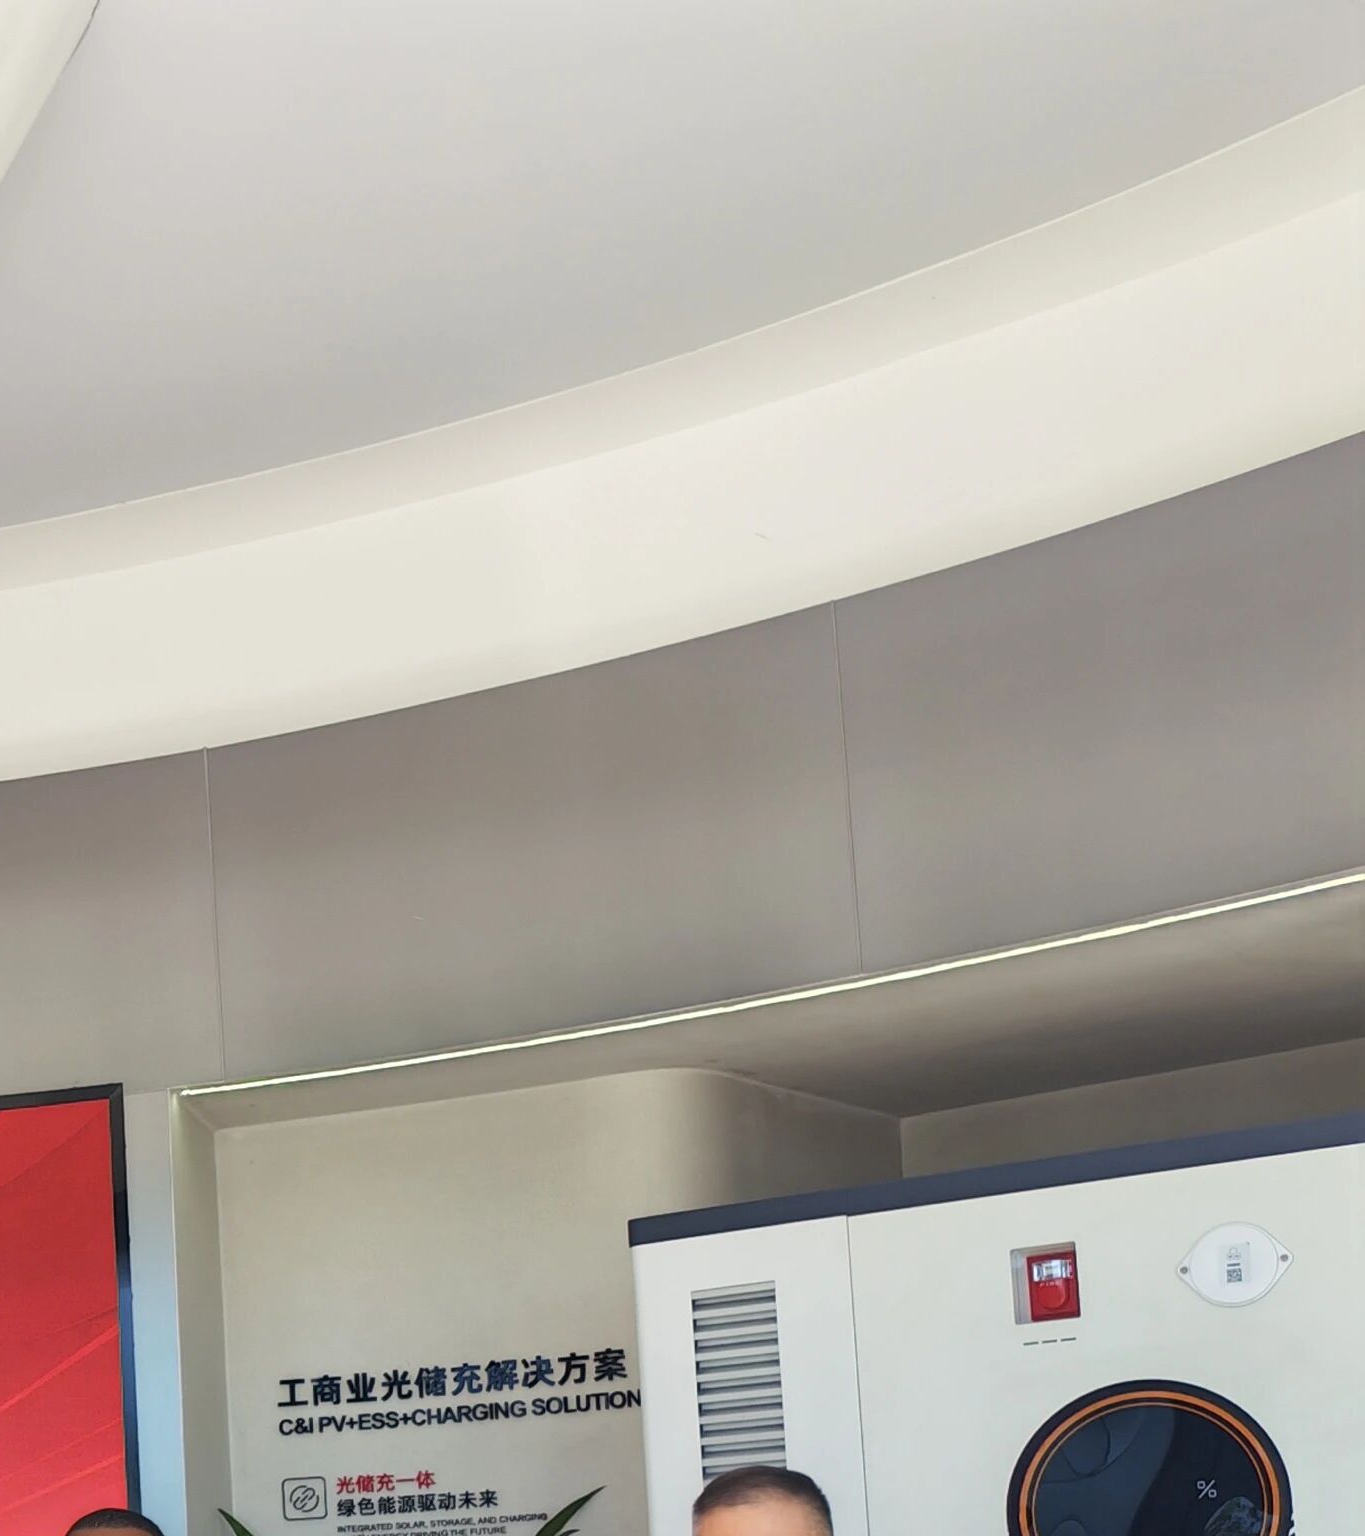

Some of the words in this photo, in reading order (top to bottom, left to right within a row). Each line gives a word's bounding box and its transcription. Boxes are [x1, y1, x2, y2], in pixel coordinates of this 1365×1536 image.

[277, 1348, 628, 1407] 工商业光储充解决方案
[279, 1417, 314, 1435] C&I
[319, 1400, 527, 1433] PV+ESS+CHARGING
[532, 1389, 641, 1416] SOLUTION
[336, 1470, 436, 1495] 光储充一体
[337, 1489, 498, 1517] 绿色能源驱动未来
[337, 1522, 393, 1533] INTEGRATED
[478, 1516, 497, 1524] AND
[499, 1513, 548, 1523] CHARGING
[450, 1528, 467, 1536] THE
[470, 1526, 506, 1536] FUTURE
